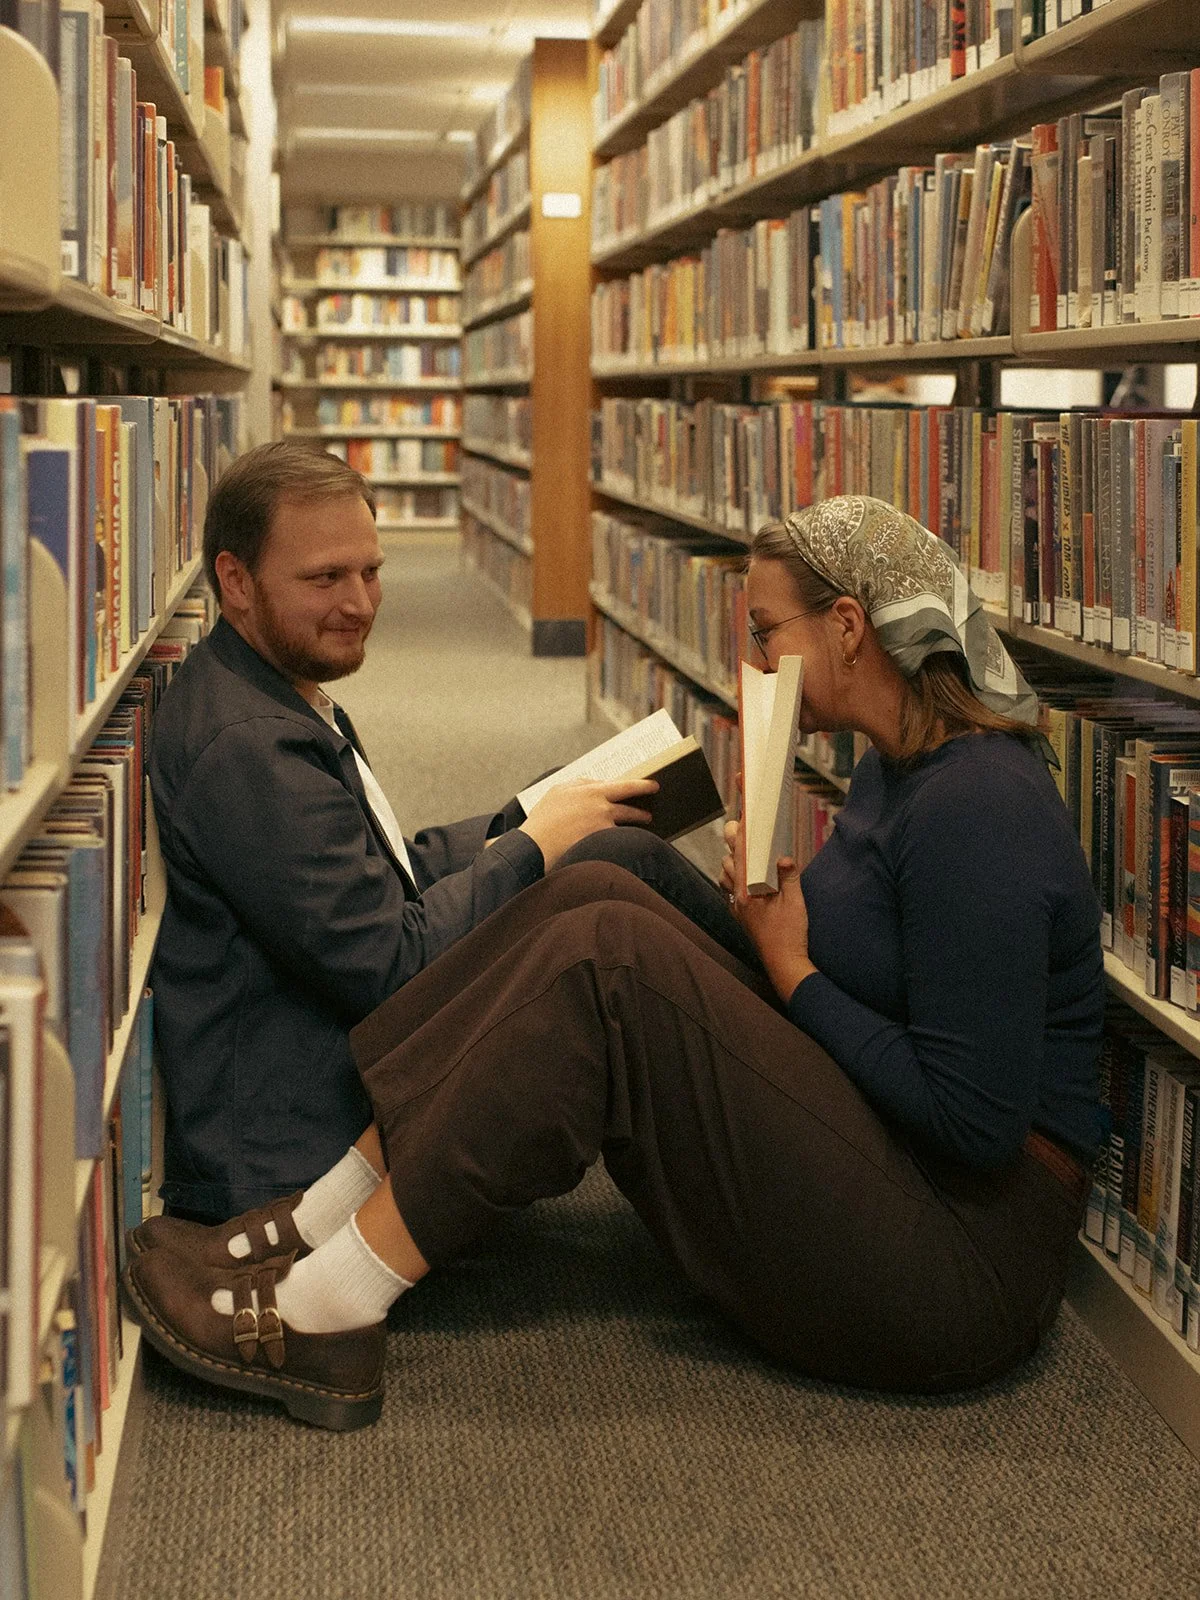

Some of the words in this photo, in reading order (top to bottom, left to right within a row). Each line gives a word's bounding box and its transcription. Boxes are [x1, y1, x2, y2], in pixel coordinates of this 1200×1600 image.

[1145, 103, 1154, 124] The
[1162, 99, 1171, 157] CONROY
[1171, 116, 1180, 139] PAT
[1145, 123, 1158, 162] Great
[1145, 165, 1157, 213] Santini
[1165, 171, 1175, 216] SOUTH
[1144, 217, 1153, 234] Pat
[1142, 235, 1153, 273] Conroy
[1165, 236, 1175, 282] BROAD
[1061, 424, 1070, 446] THE
[1101, 431, 1110, 457] THE
[1012, 428, 1022, 488] STEPHEN
[1061, 448, 1071, 518] MARAUDERS
[1101, 469, 1110, 533] SAVAGE
[1012, 491, 1022, 547] COONTS
[1146, 518, 1155, 548] KISS
[1063, 535, 1071, 562] TOM
[1101, 544, 1110, 591] KIND
[1146, 553, 1155, 577] THE
[1062, 566, 1071, 598] COOP
[1146, 581, 1155, 610] GIRL
[1102, 738, 1110, 790] BERNARD
[1174, 917, 1183, 957] ROOM
[1146, 1069, 1159, 1140] CATHERINE
[1182, 1098, 1195, 1170] RECKONING
[1143, 1141, 1155, 1198] COULTER
